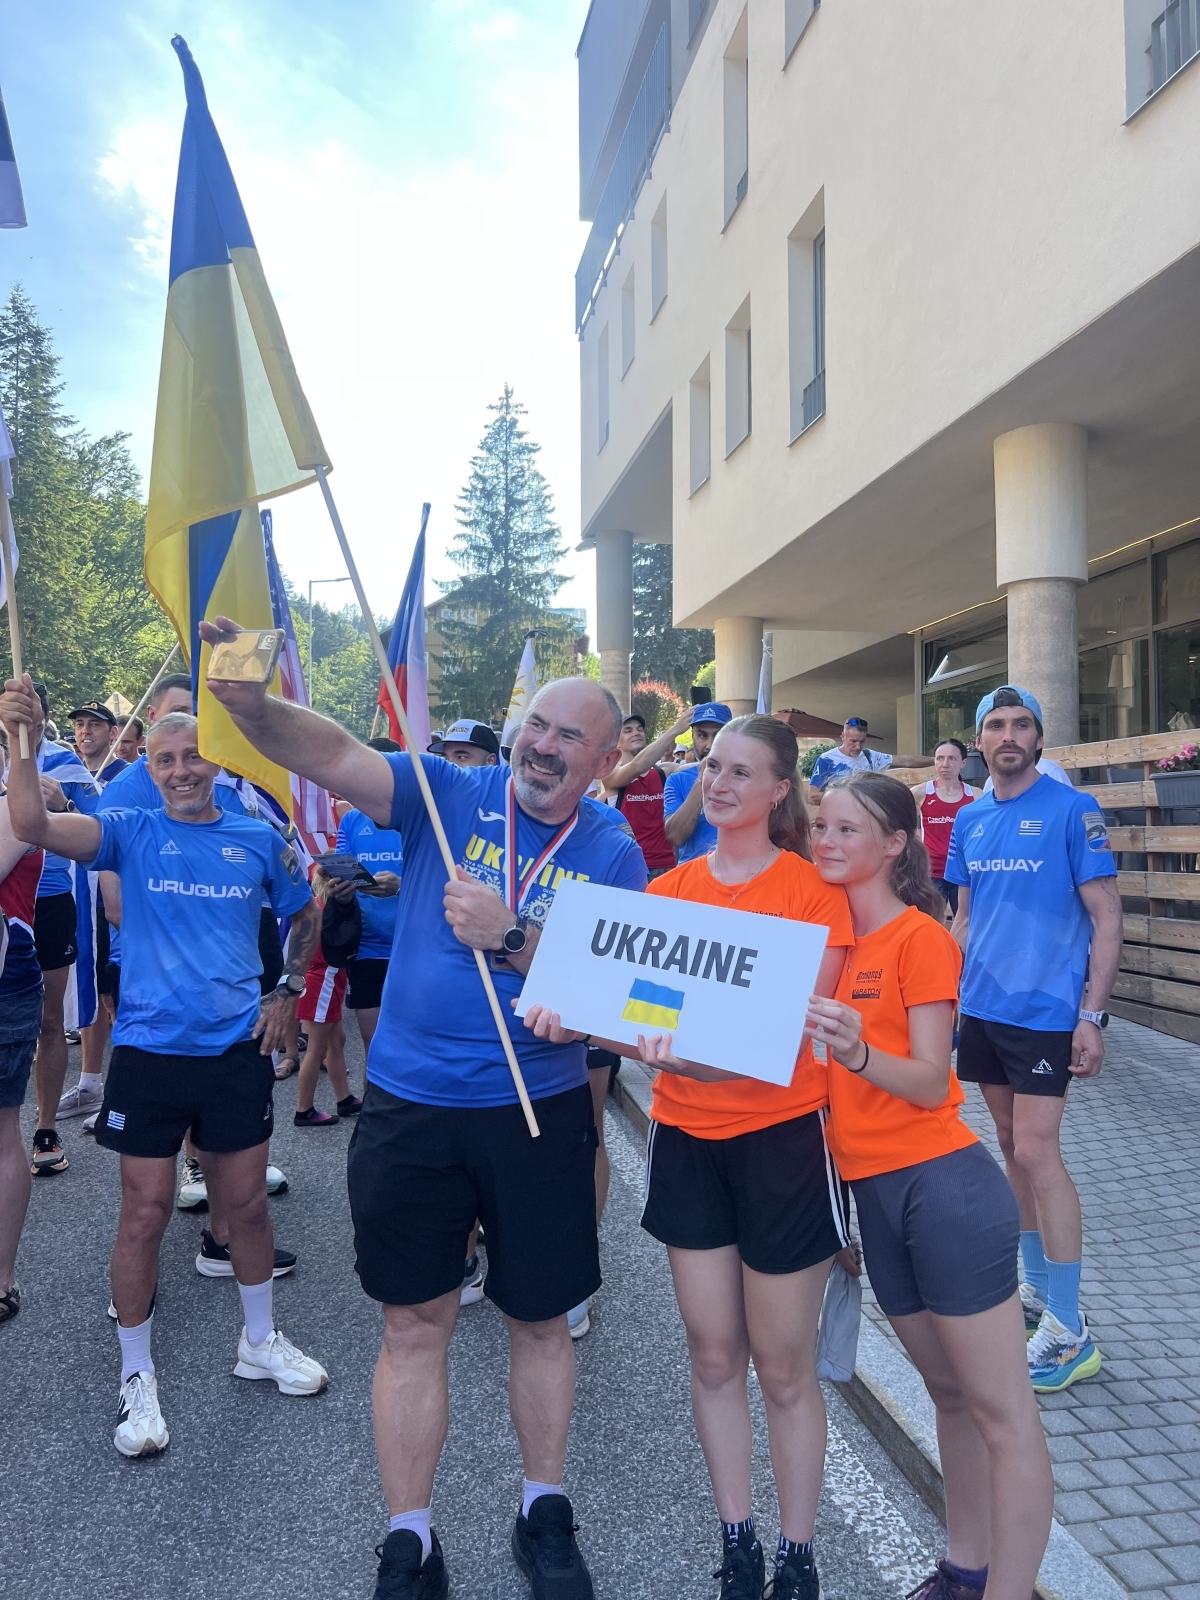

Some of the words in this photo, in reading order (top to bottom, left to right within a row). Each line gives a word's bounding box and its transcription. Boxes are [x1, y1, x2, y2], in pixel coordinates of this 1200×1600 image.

[357, 852, 403, 862] RUGU
[465, 833, 590, 890] UKIN
[147, 878, 253, 899] URUGUAY
[590, 918, 759, 989] UKRAINE
